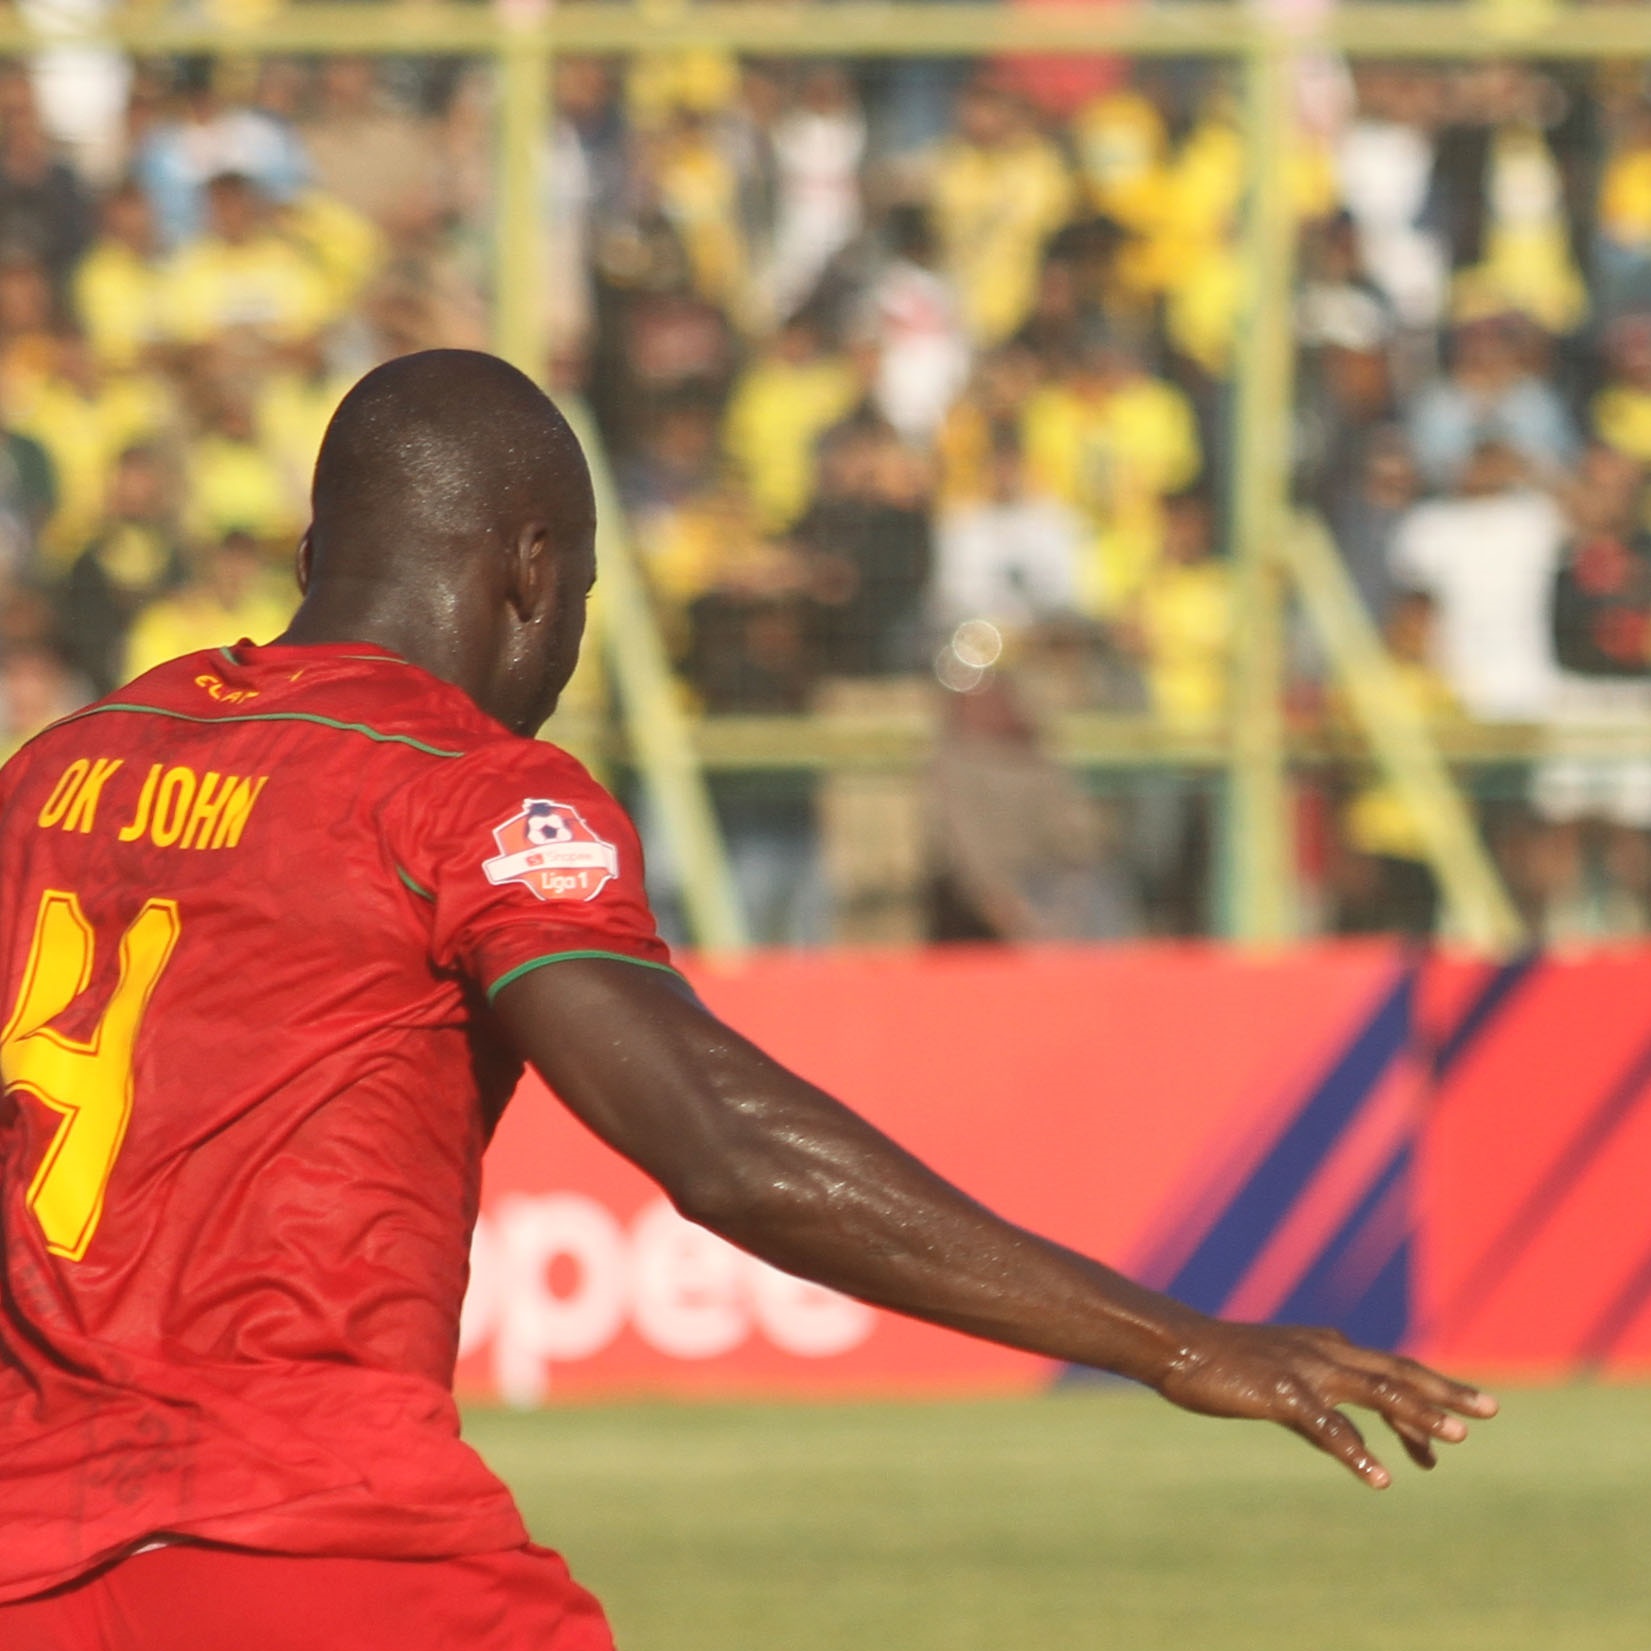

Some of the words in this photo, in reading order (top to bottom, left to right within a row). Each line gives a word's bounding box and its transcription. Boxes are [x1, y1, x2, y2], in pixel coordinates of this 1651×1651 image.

[38, 758, 124, 833] OK
[118, 763, 269, 850] JOHN
[541, 871, 577, 894] Liga
[578, 871, 588, 888] 1
[0, 888, 181, 1262] 4
